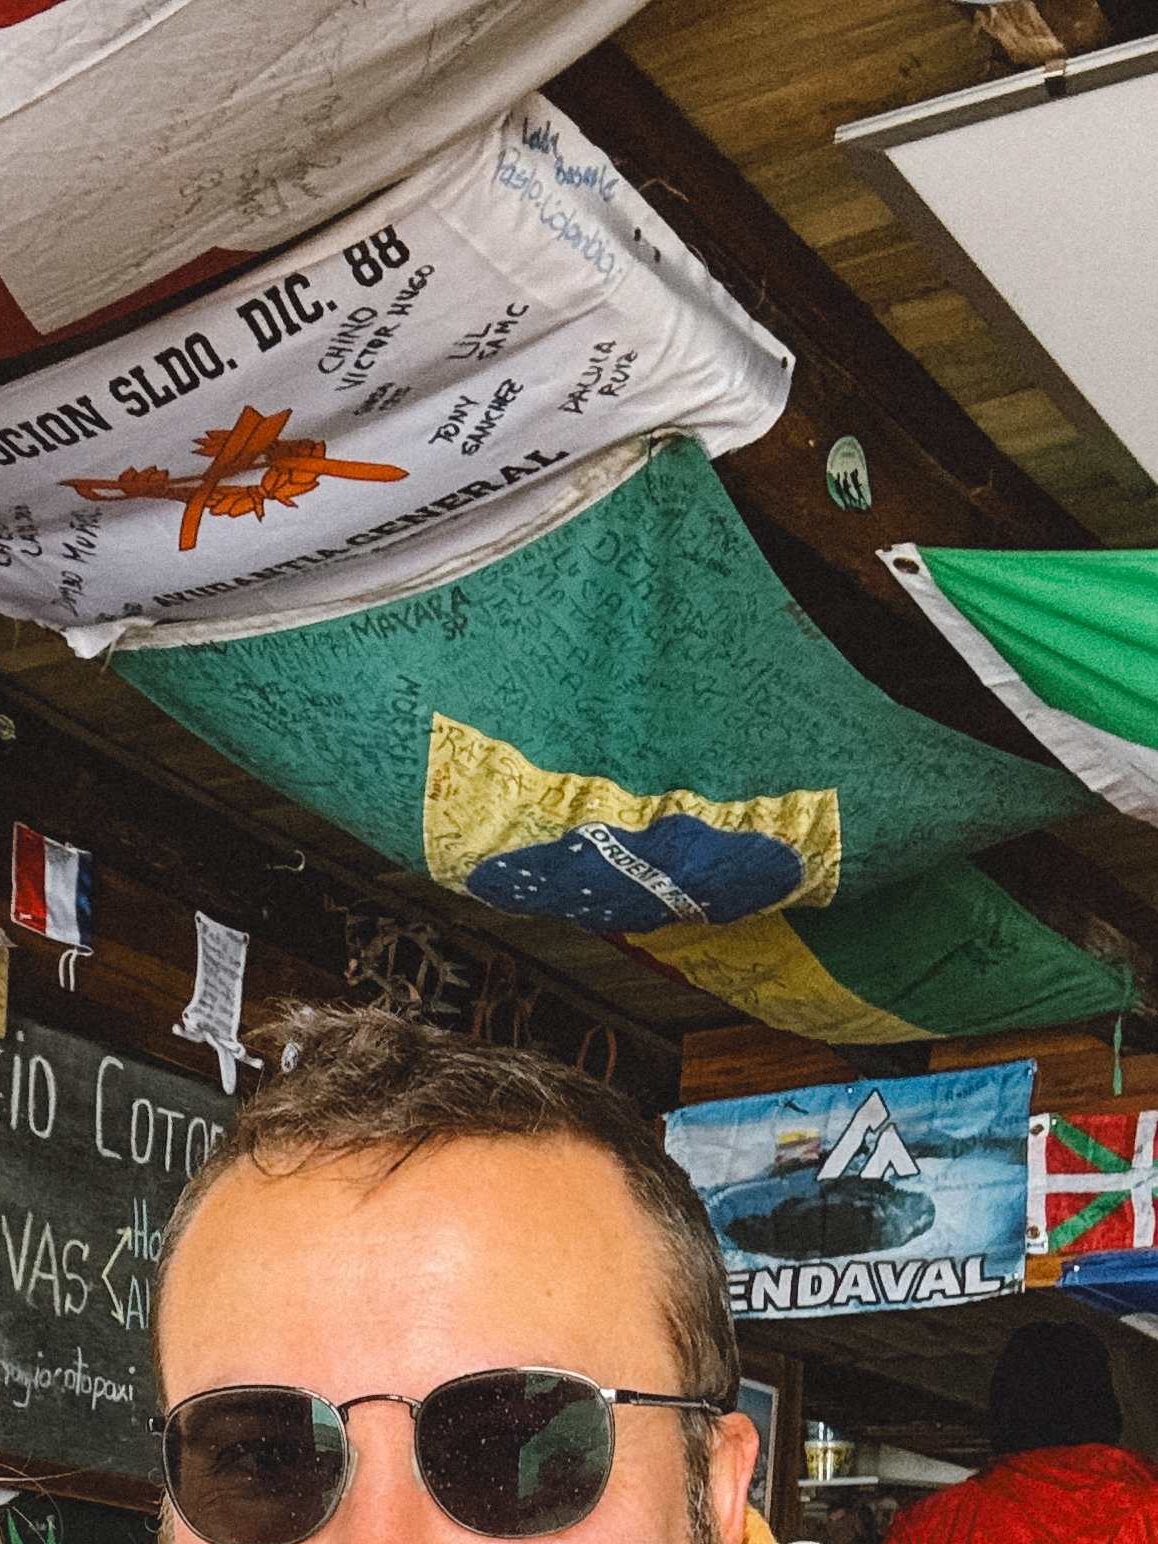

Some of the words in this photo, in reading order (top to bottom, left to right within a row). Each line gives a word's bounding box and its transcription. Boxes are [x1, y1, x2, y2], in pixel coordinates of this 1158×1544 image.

[108, 332, 239, 419] SLDO.
[236, 272, 338, 353] DIC.
[343, 223, 411, 288] 88
[317, 306, 379, 375] CHINO
[334, 322, 401, 392] VICTOR
[386, 264, 436, 316] HUGO
[427, 393, 480, 445] TONY
[344, 447, 571, 551] GENERAL
[349, 585, 472, 644] MAYARA
